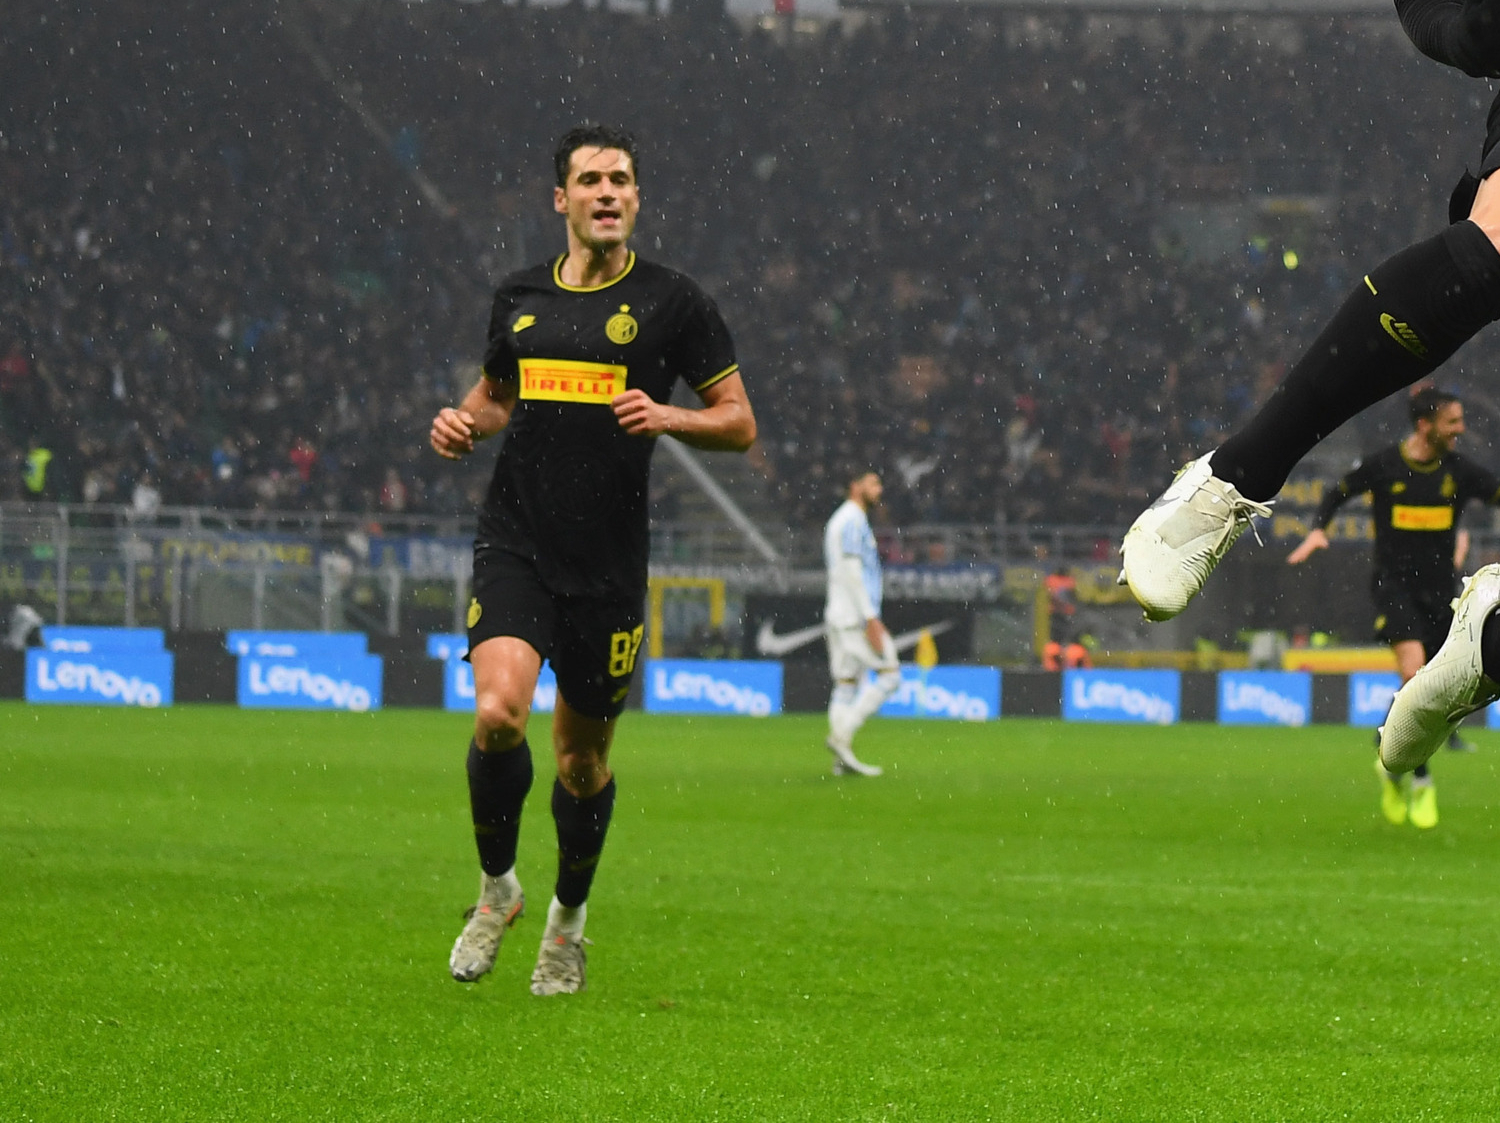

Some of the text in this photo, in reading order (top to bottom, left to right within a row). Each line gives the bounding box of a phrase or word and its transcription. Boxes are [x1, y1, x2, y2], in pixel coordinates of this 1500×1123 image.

[524, 368, 615, 395] PIRELLI
[609, 623, 645, 678] 87
[37, 657, 162, 709] Lenovo
[250, 662, 372, 713] Lenovo
[654, 668, 773, 716] Lenovo
